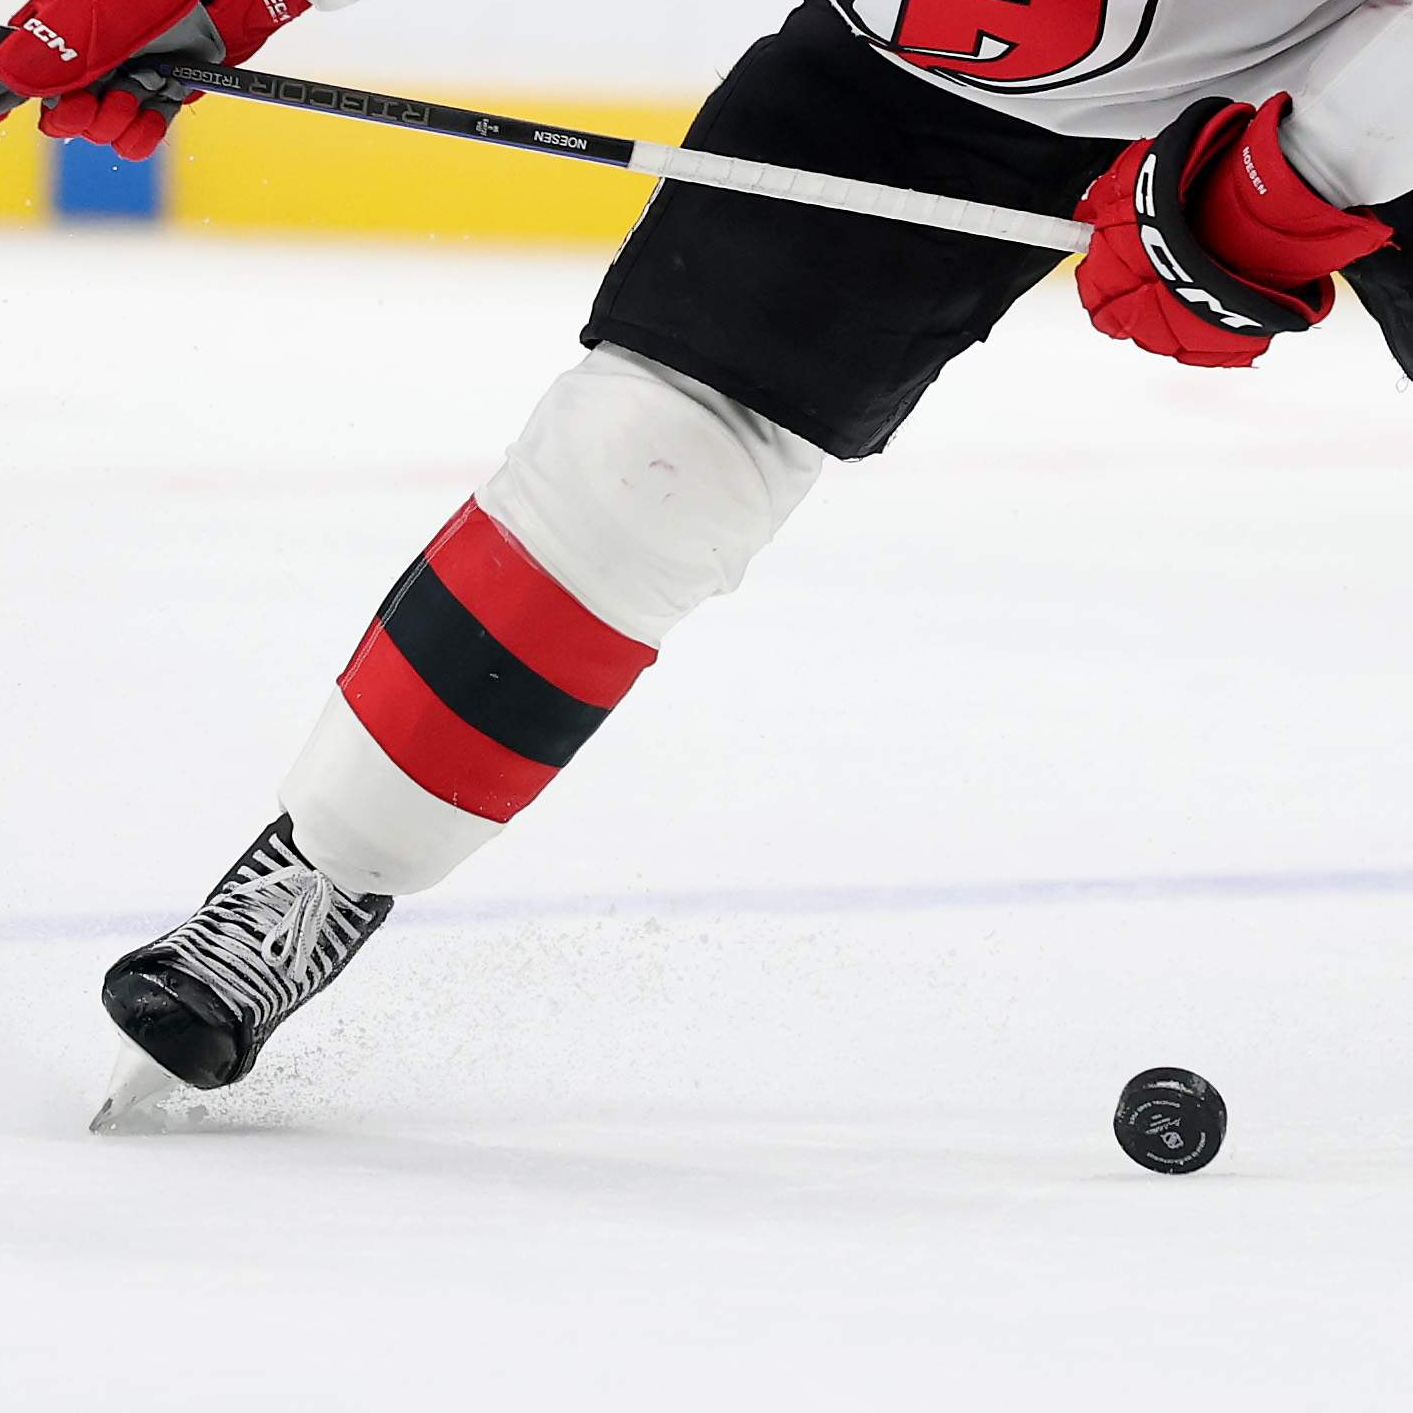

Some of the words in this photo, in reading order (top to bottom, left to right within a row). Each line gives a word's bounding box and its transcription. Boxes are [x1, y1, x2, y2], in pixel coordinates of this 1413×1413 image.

[23, 17, 78, 62] CCM
[172, 64, 242, 90] TRIGGER
[247, 75, 430, 125] RIBCOR
[533, 130, 588, 151] NOESEN
[1242, 146, 1267, 195] NOESEN
[1134, 152, 1264, 328] CCM
